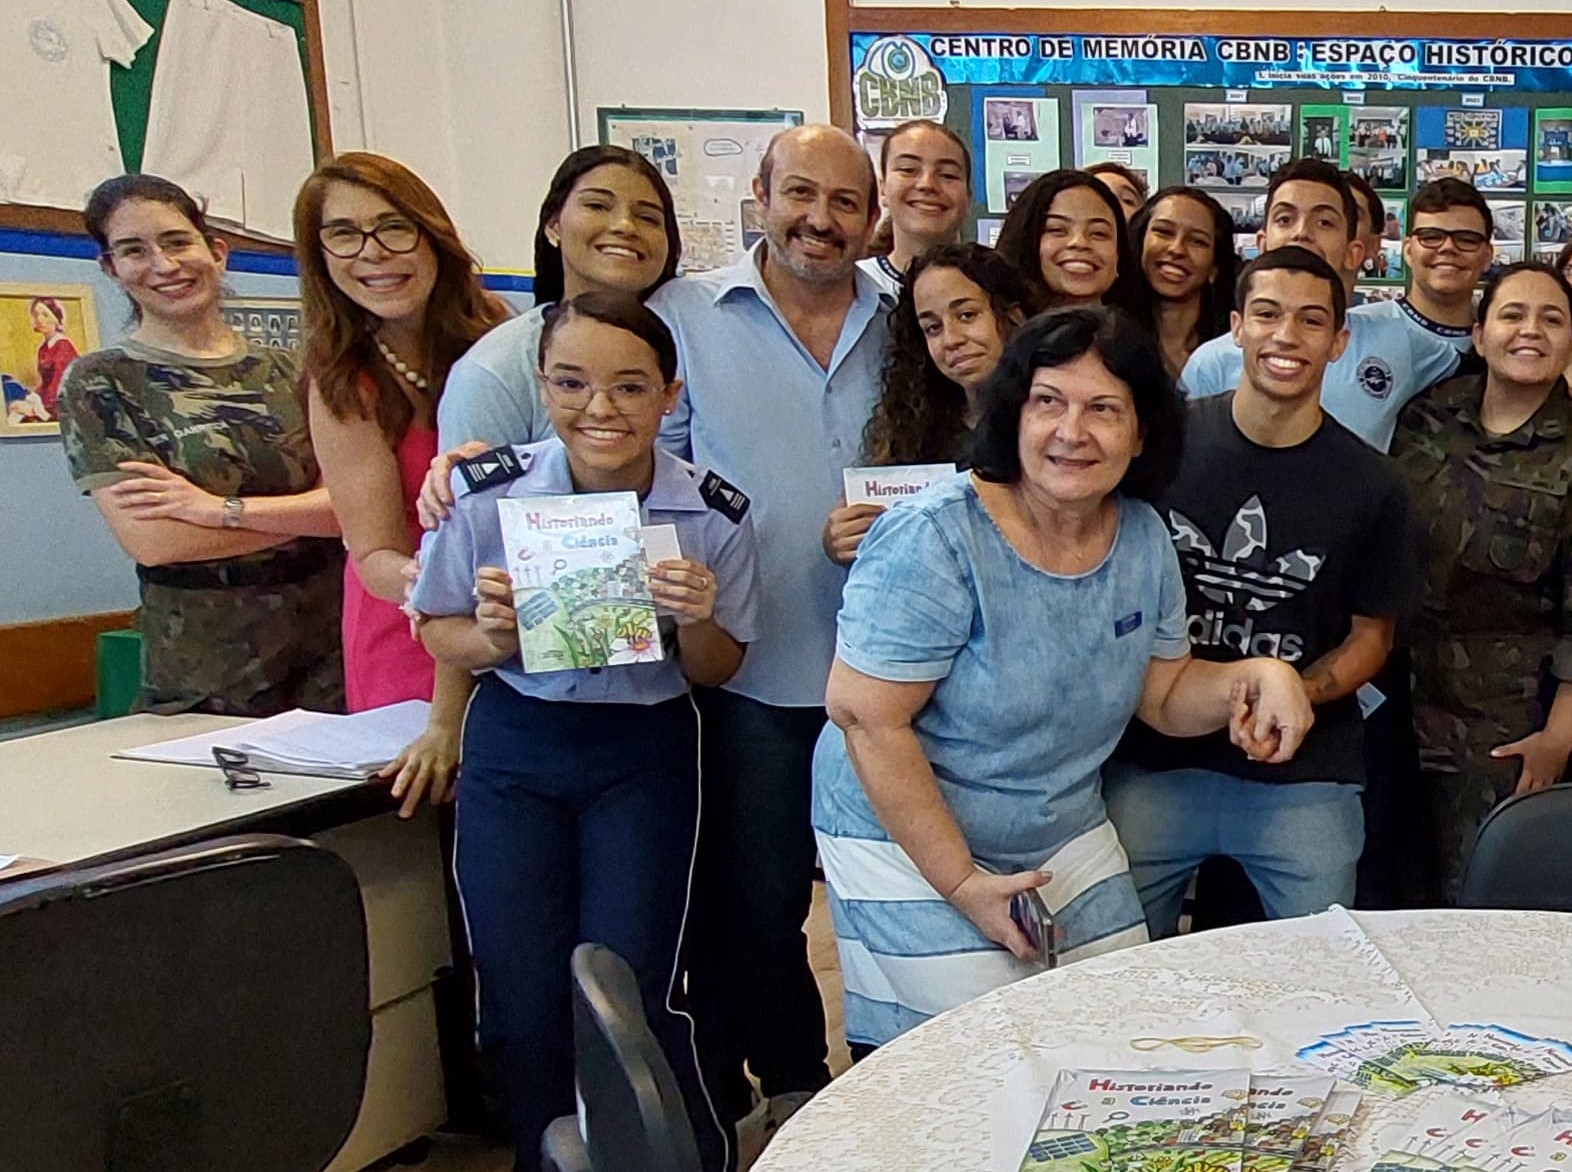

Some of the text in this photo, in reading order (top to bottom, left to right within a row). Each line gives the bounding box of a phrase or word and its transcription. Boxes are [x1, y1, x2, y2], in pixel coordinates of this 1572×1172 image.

[930, 38, 1030, 57] CENTRO
[1041, 40, 1073, 57] DE
[1084, 35, 1205, 60] MEMÓRIA
[1218, 42, 1289, 61] CBNB
[1312, 43, 1416, 68] ESPAÇO
[859, 72, 942, 118] CBNB
[525, 512, 614, 530] Historiando
[1088, 1078, 1213, 1092] Historiando
[1130, 1095, 1211, 1106] Ciência
